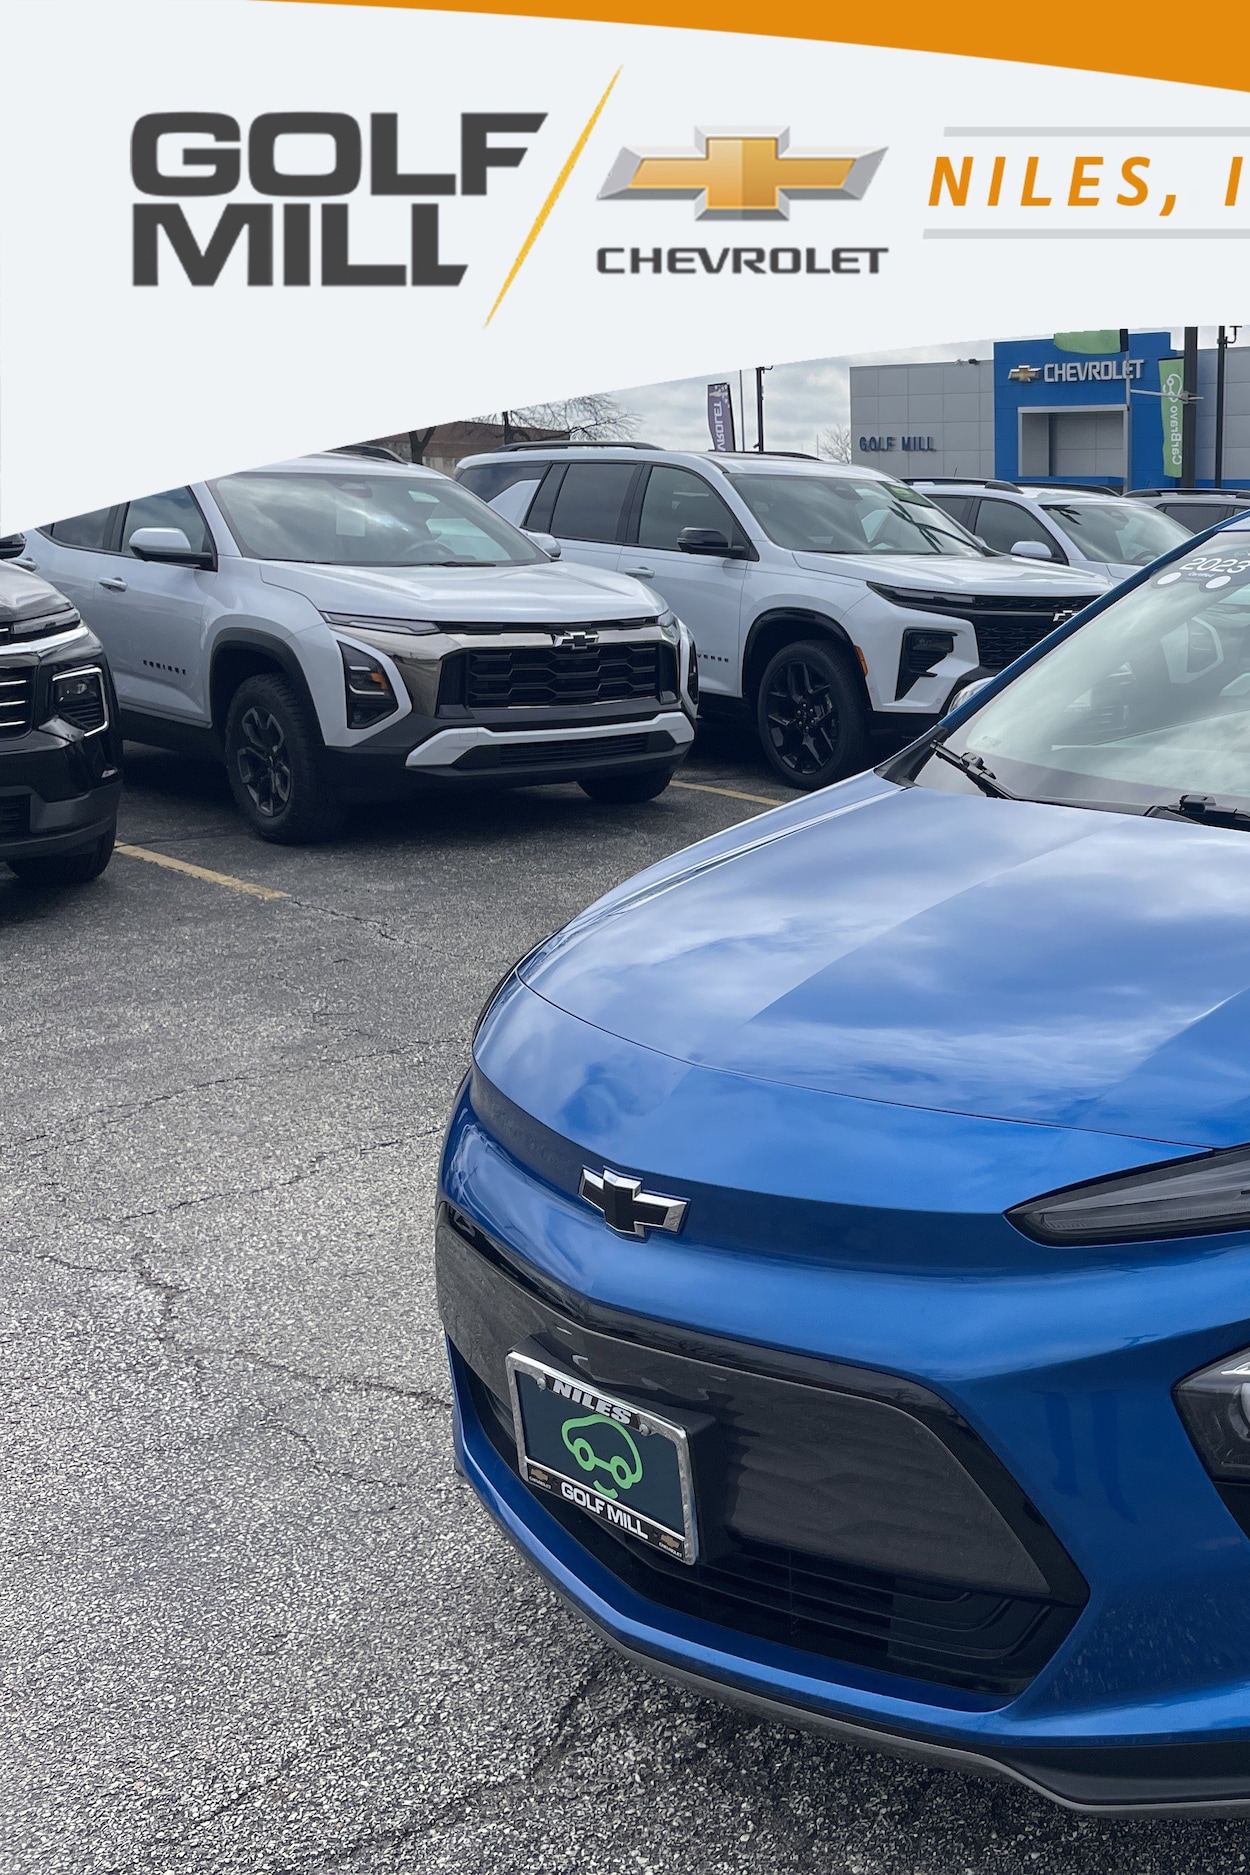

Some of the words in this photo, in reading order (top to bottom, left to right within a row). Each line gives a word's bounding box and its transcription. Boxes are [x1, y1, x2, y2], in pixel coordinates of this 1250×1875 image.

[1044, 359, 1144, 383] CHEVROLET
[860, 436, 894, 452] GOLF
[902, 436, 936, 452] MILL
[552, 1379, 632, 1425] NILES
[560, 1481, 605, 1514] GOLF
[607, 1506, 649, 1540] MILL
